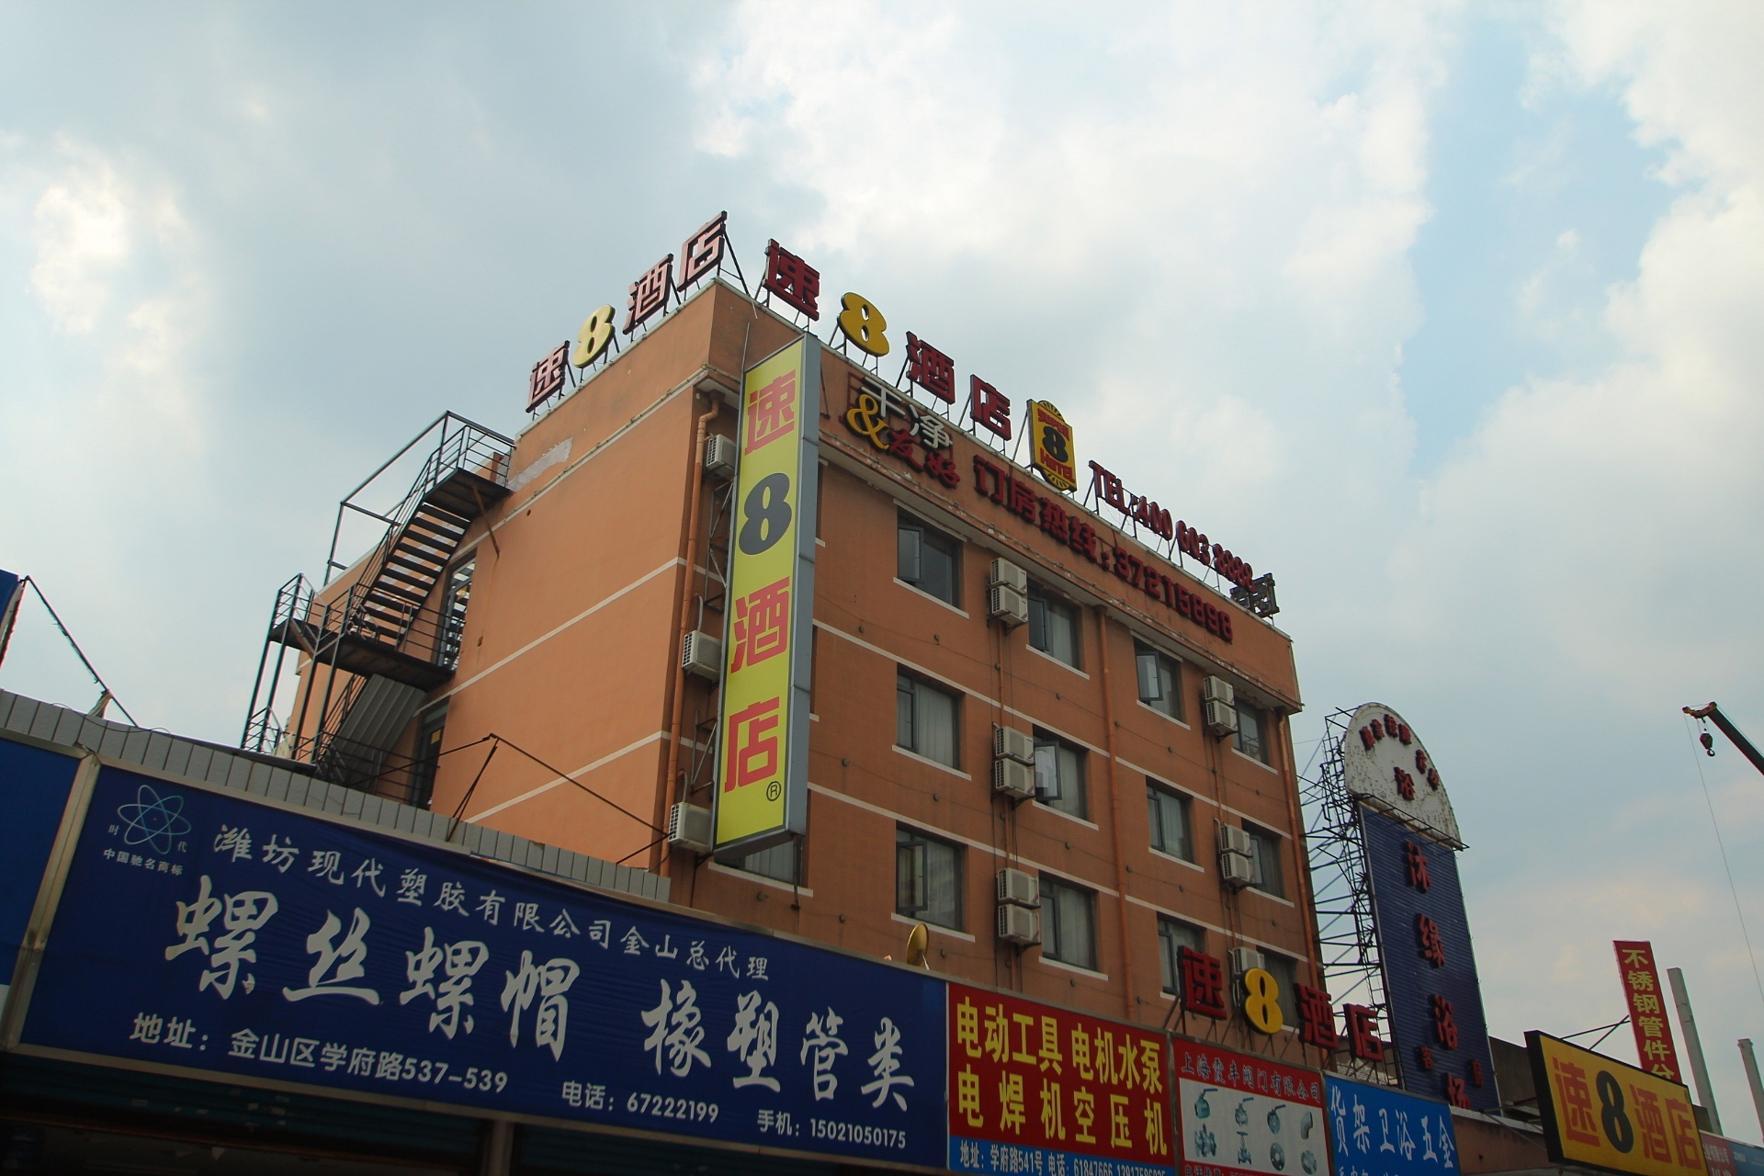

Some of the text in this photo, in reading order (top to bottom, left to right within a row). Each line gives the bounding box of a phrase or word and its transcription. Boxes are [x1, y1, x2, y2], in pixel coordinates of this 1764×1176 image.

[526, 211, 728, 413] 速8酒店
[763, 239, 1012, 441] 速8酒店
[861, 375, 953, 449] 干净
[725, 369, 797, 792] 速8酒店
[165, 874, 915, 1112] 螺丝螺帽 橡塑管类
[956, 996, 1164, 1095] 电动工具 电机水泵
[1177, 945, 1385, 1062] 速8酒店
[1552, 1056, 1702, 1171] 速8酒店
